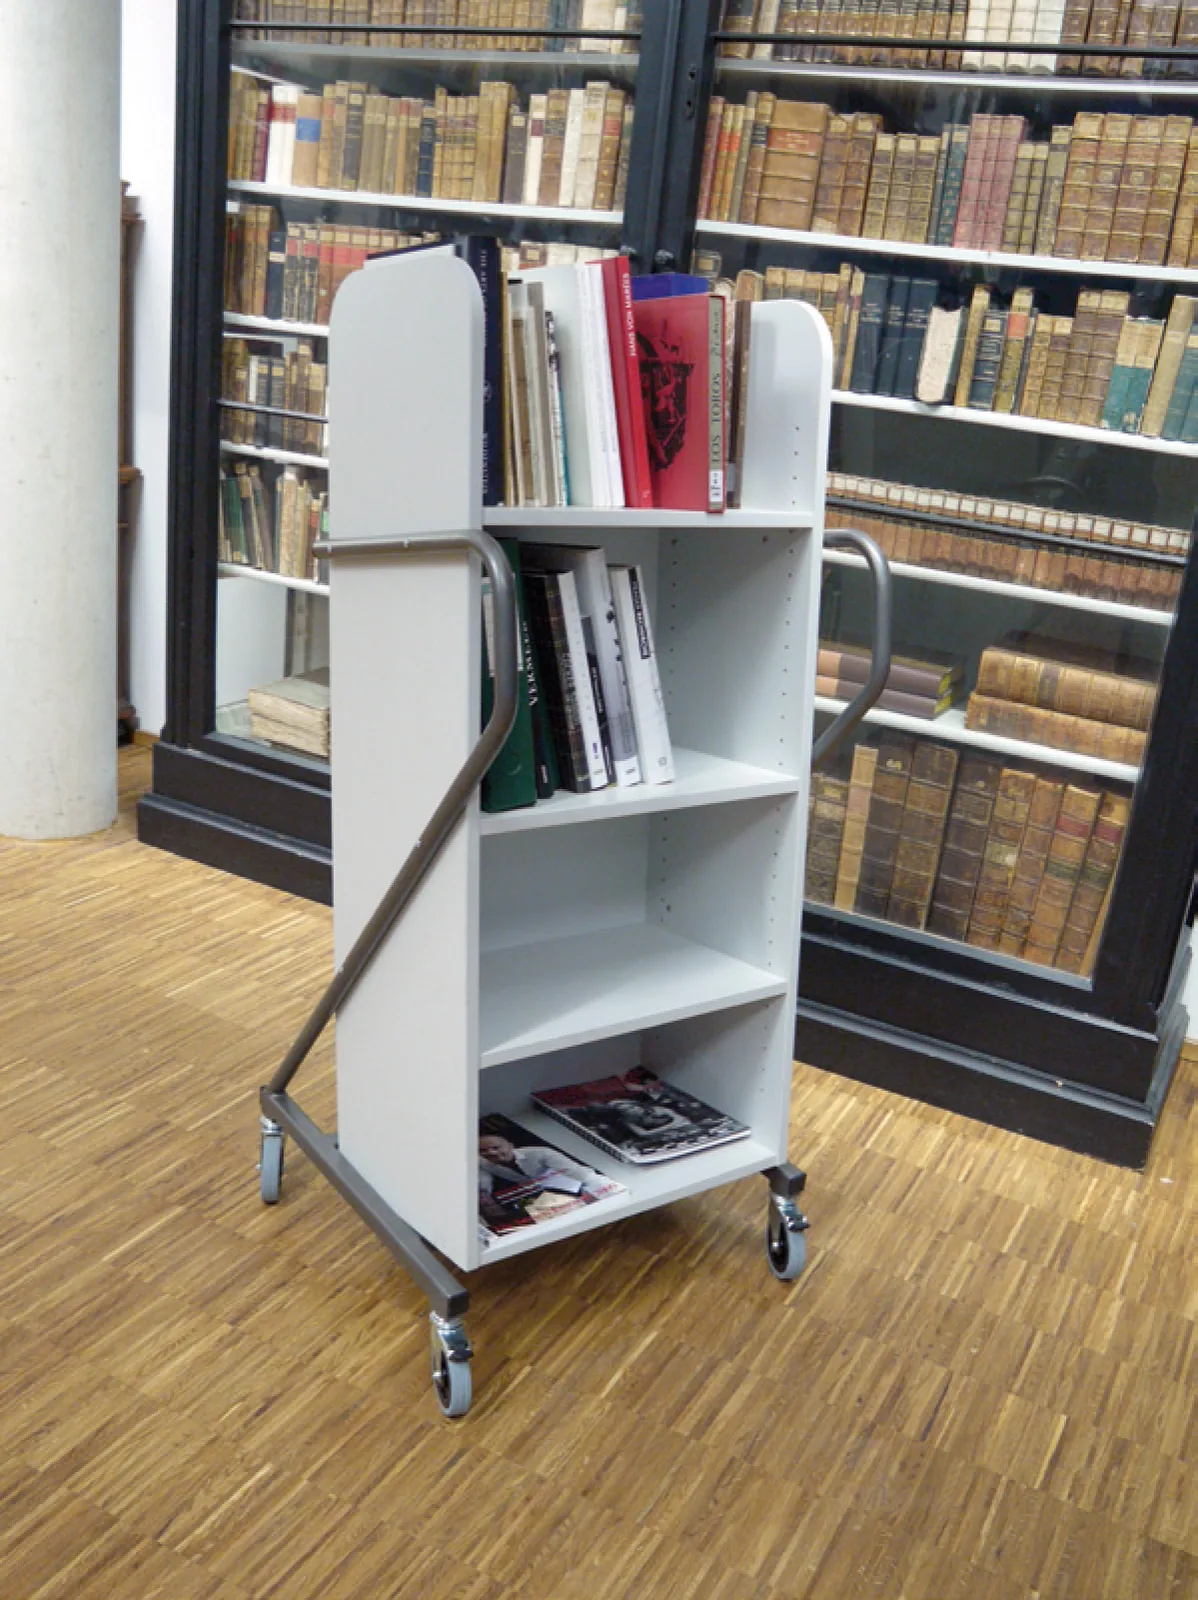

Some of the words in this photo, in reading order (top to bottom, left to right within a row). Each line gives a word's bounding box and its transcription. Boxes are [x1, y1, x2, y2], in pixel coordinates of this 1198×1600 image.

[626, 310, 634, 331] VON
[628, 333, 637, 357] HANS
[711, 371, 721, 423] TOROS
[711, 435, 721, 464] LOS
